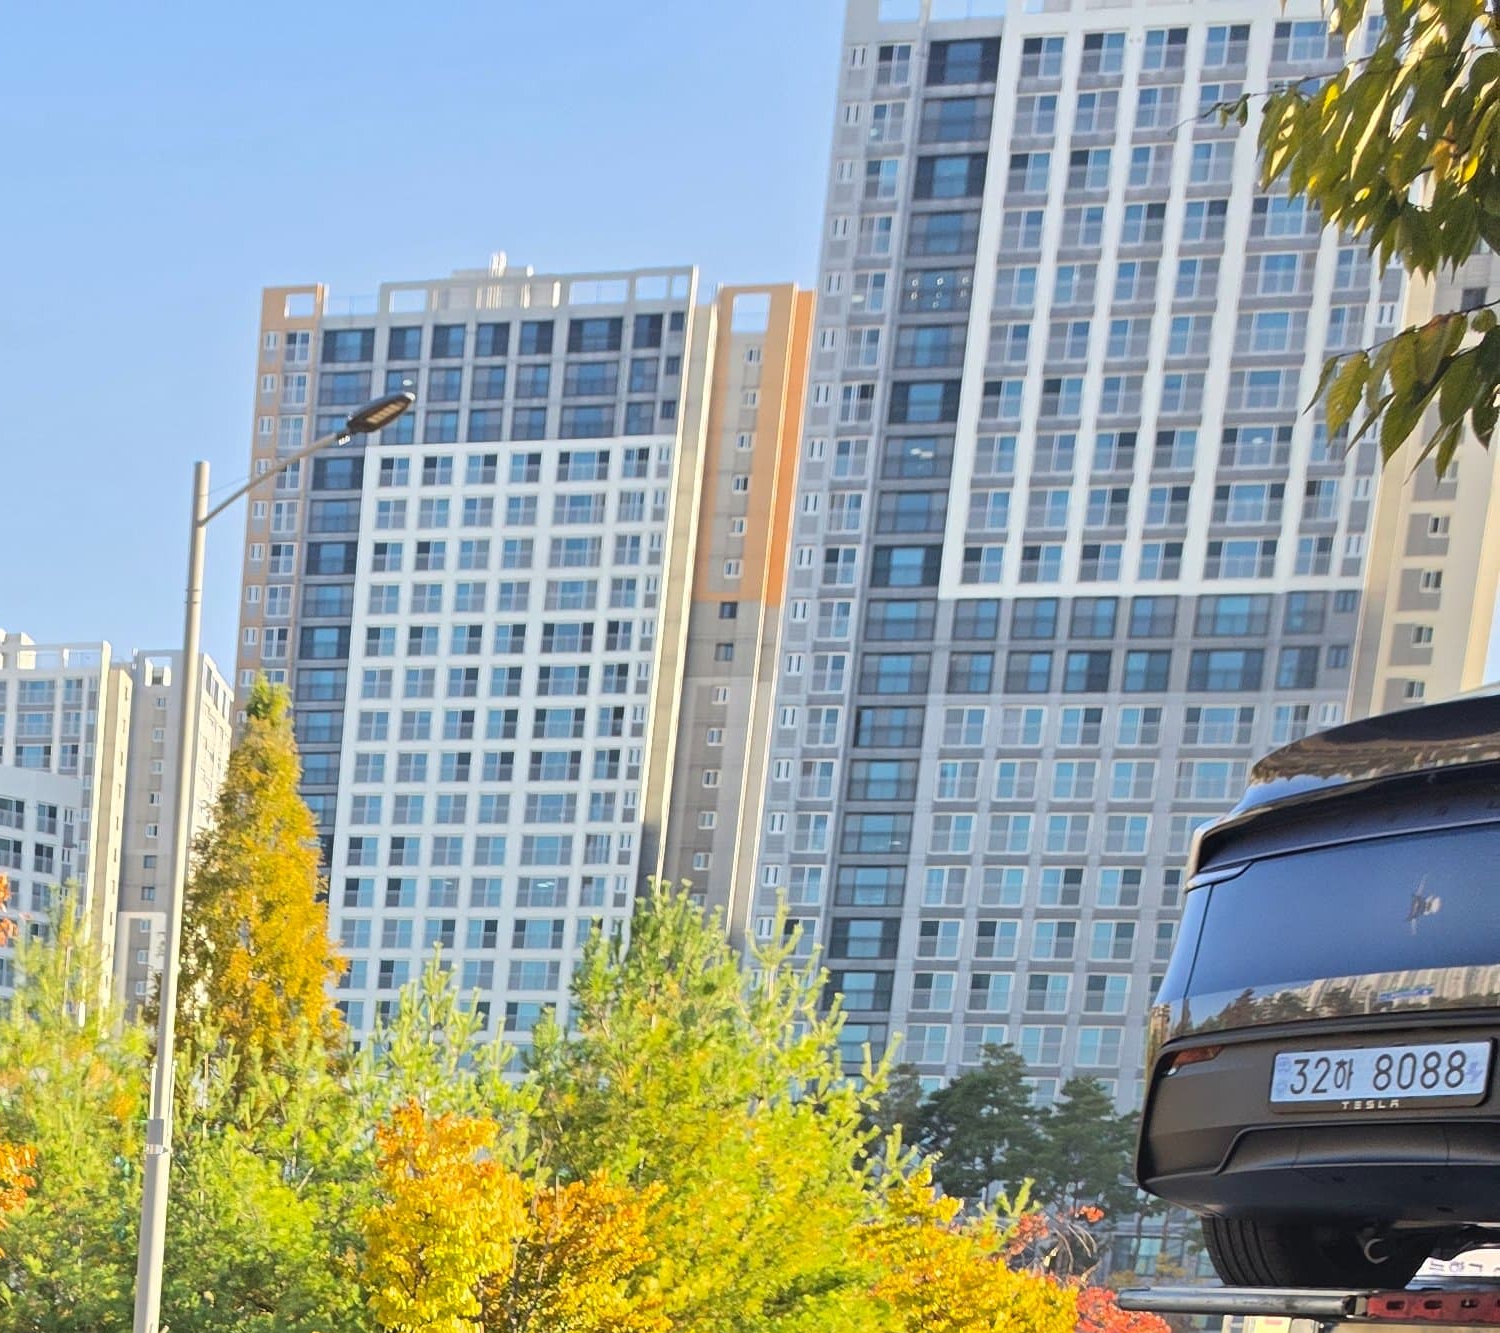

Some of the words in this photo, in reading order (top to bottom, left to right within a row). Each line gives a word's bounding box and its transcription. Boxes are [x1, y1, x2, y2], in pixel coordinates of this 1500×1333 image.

[1290, 1057, 1354, 1094] 32하
[1372, 1050, 1466, 1091] 8088
[1341, 1099, 1400, 1110] TESLA
